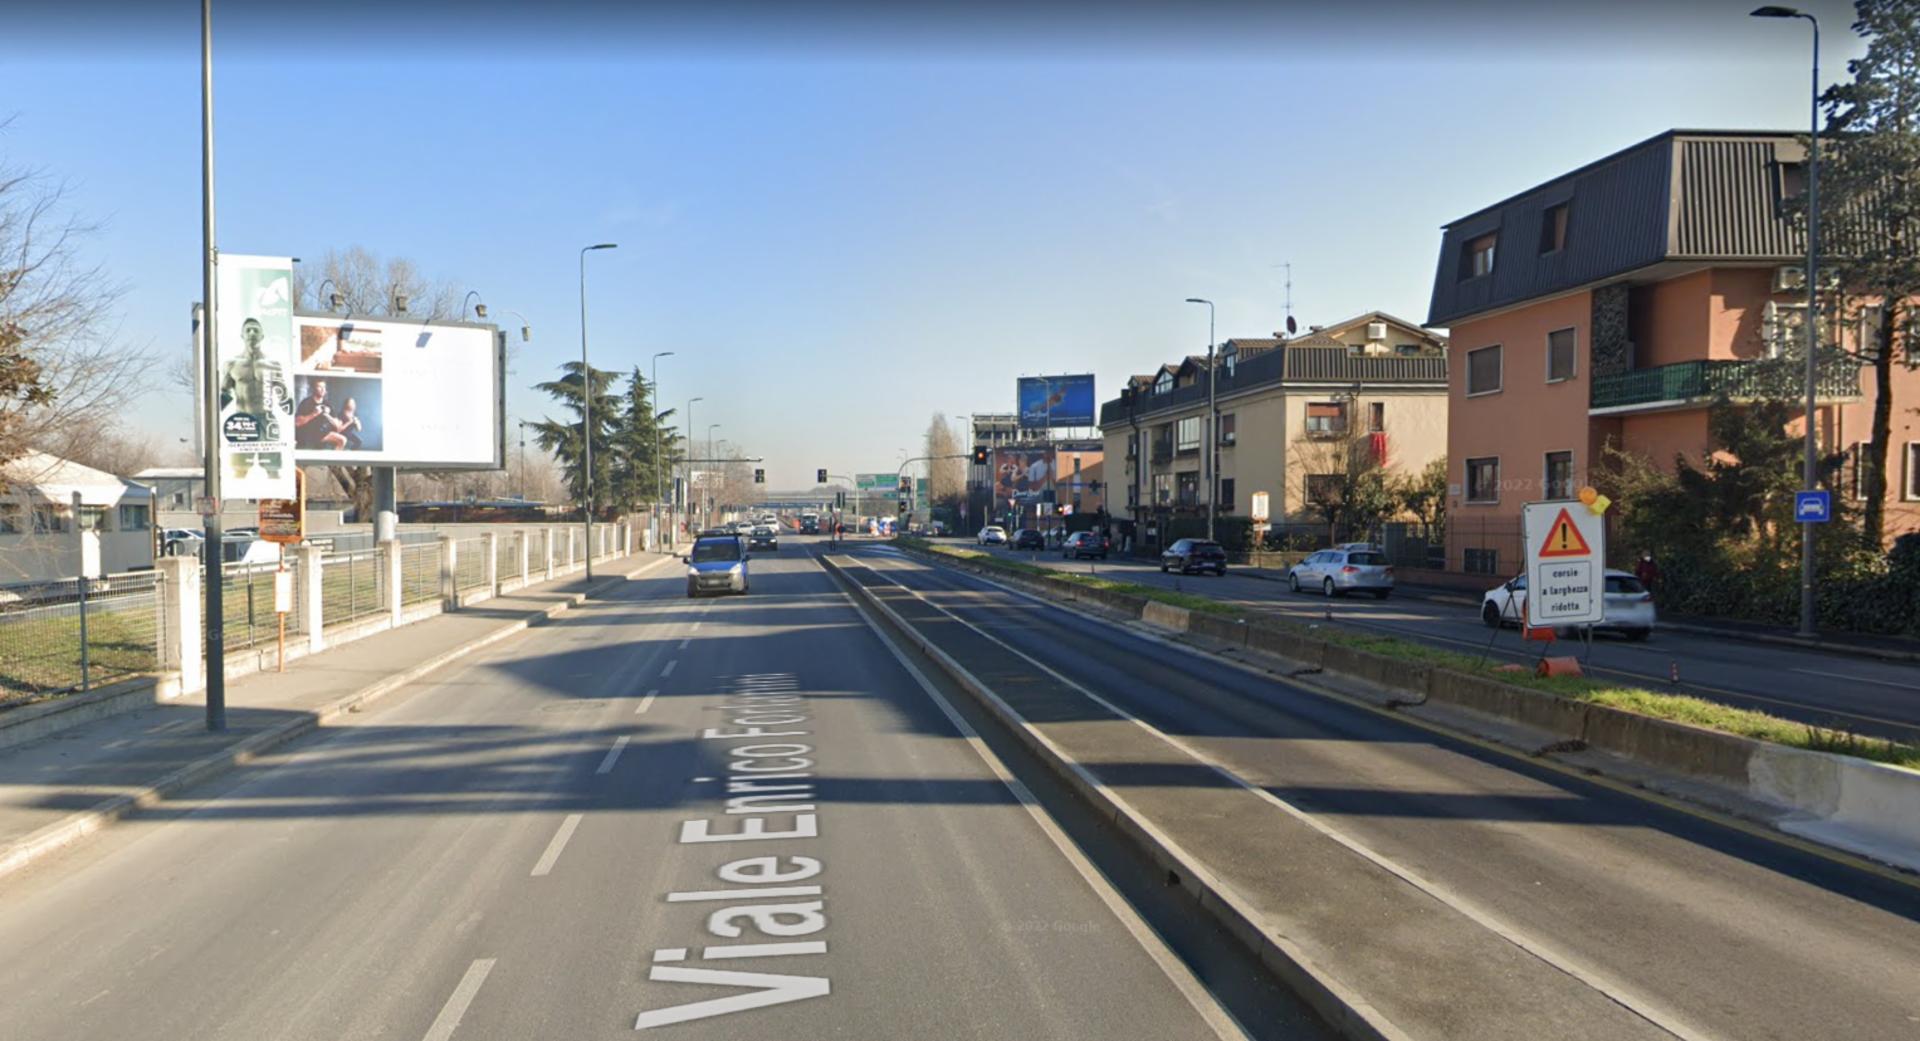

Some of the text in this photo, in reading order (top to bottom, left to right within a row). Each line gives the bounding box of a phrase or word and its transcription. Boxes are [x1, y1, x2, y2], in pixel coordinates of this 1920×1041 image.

[1552, 568, 1579, 578] corsie
[1550, 586, 1588, 596] larghezza
[1551, 602, 1580, 612] ridotta
